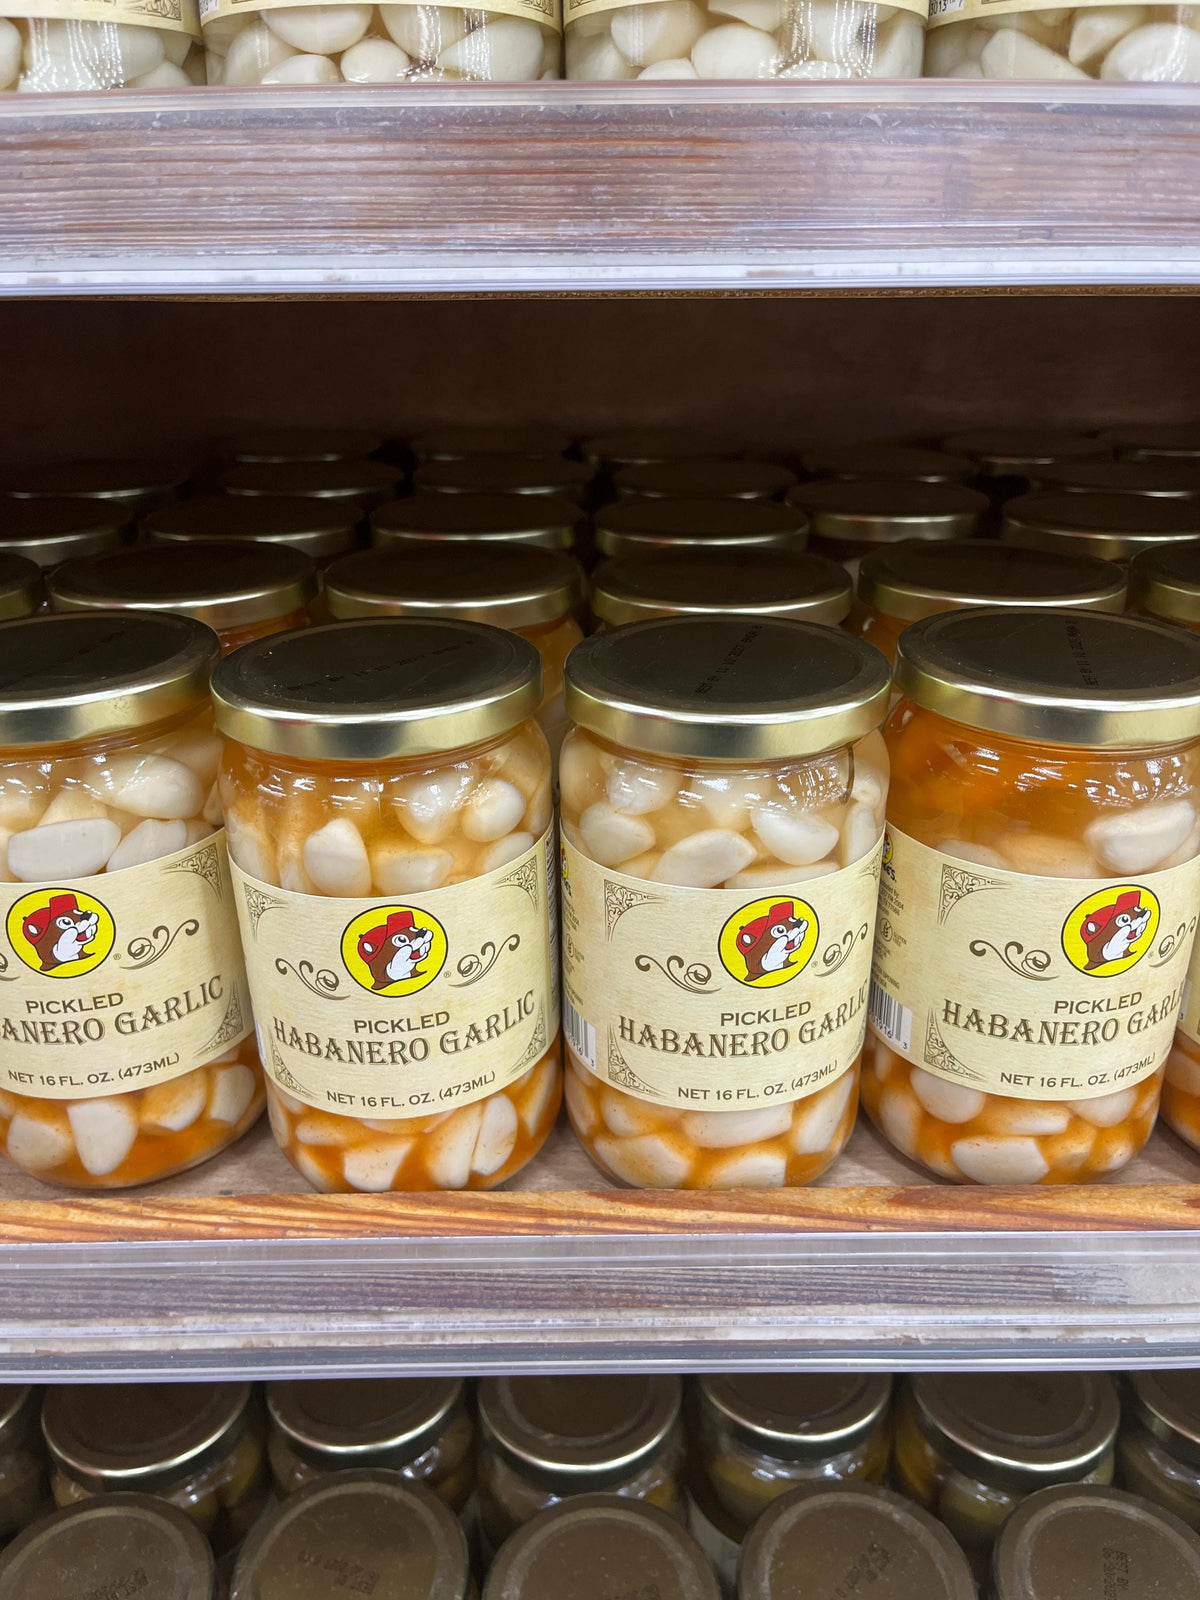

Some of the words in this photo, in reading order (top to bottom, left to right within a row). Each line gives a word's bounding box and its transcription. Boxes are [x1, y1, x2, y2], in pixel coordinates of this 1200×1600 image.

[26, 993, 123, 1014] PICKLED
[114, 975, 223, 1035] GARLIC
[721, 1001, 811, 1027] PICKLED
[942, 998, 1119, 1046] HABANERO
[1054, 992, 1142, 1015] PICKLED
[273, 1016, 430, 1066] HABANERO
[439, 989, 535, 1055] GARLIC
[354, 1011, 450, 1034] PICKLED
[619, 1014, 790, 1058] HABANERO
[8, 1069, 34, 1084] NET
[40, 1075, 56, 1086] 16
[59, 1075, 83, 1086] FL.
[87, 1072, 114, 1084] OZ.
[118, 1052, 180, 1080] (473ML)
[678, 1087, 710, 1100] NET
[716, 1090, 732, 1100] 16
[737, 1088, 760, 1100] FL.
[763, 1082, 787, 1096] OZ.
[791, 1059, 838, 1091] (473ML)
[1000, 1072, 1034, 1086] NET
[1040, 1077, 1057, 1088] 16
[1060, 1077, 1083, 1088] FL.
[1087, 1073, 1110, 1086] OZ.
[1113, 1051, 1156, 1081] (473ML)
[327, 1090, 356, 1105] NET
[361, 1096, 377, 1108] 16
[381, 1096, 405, 1108] FL.
[409, 1092, 435, 1106] OZ.
[439, 1070, 496, 1101] (473ML)
